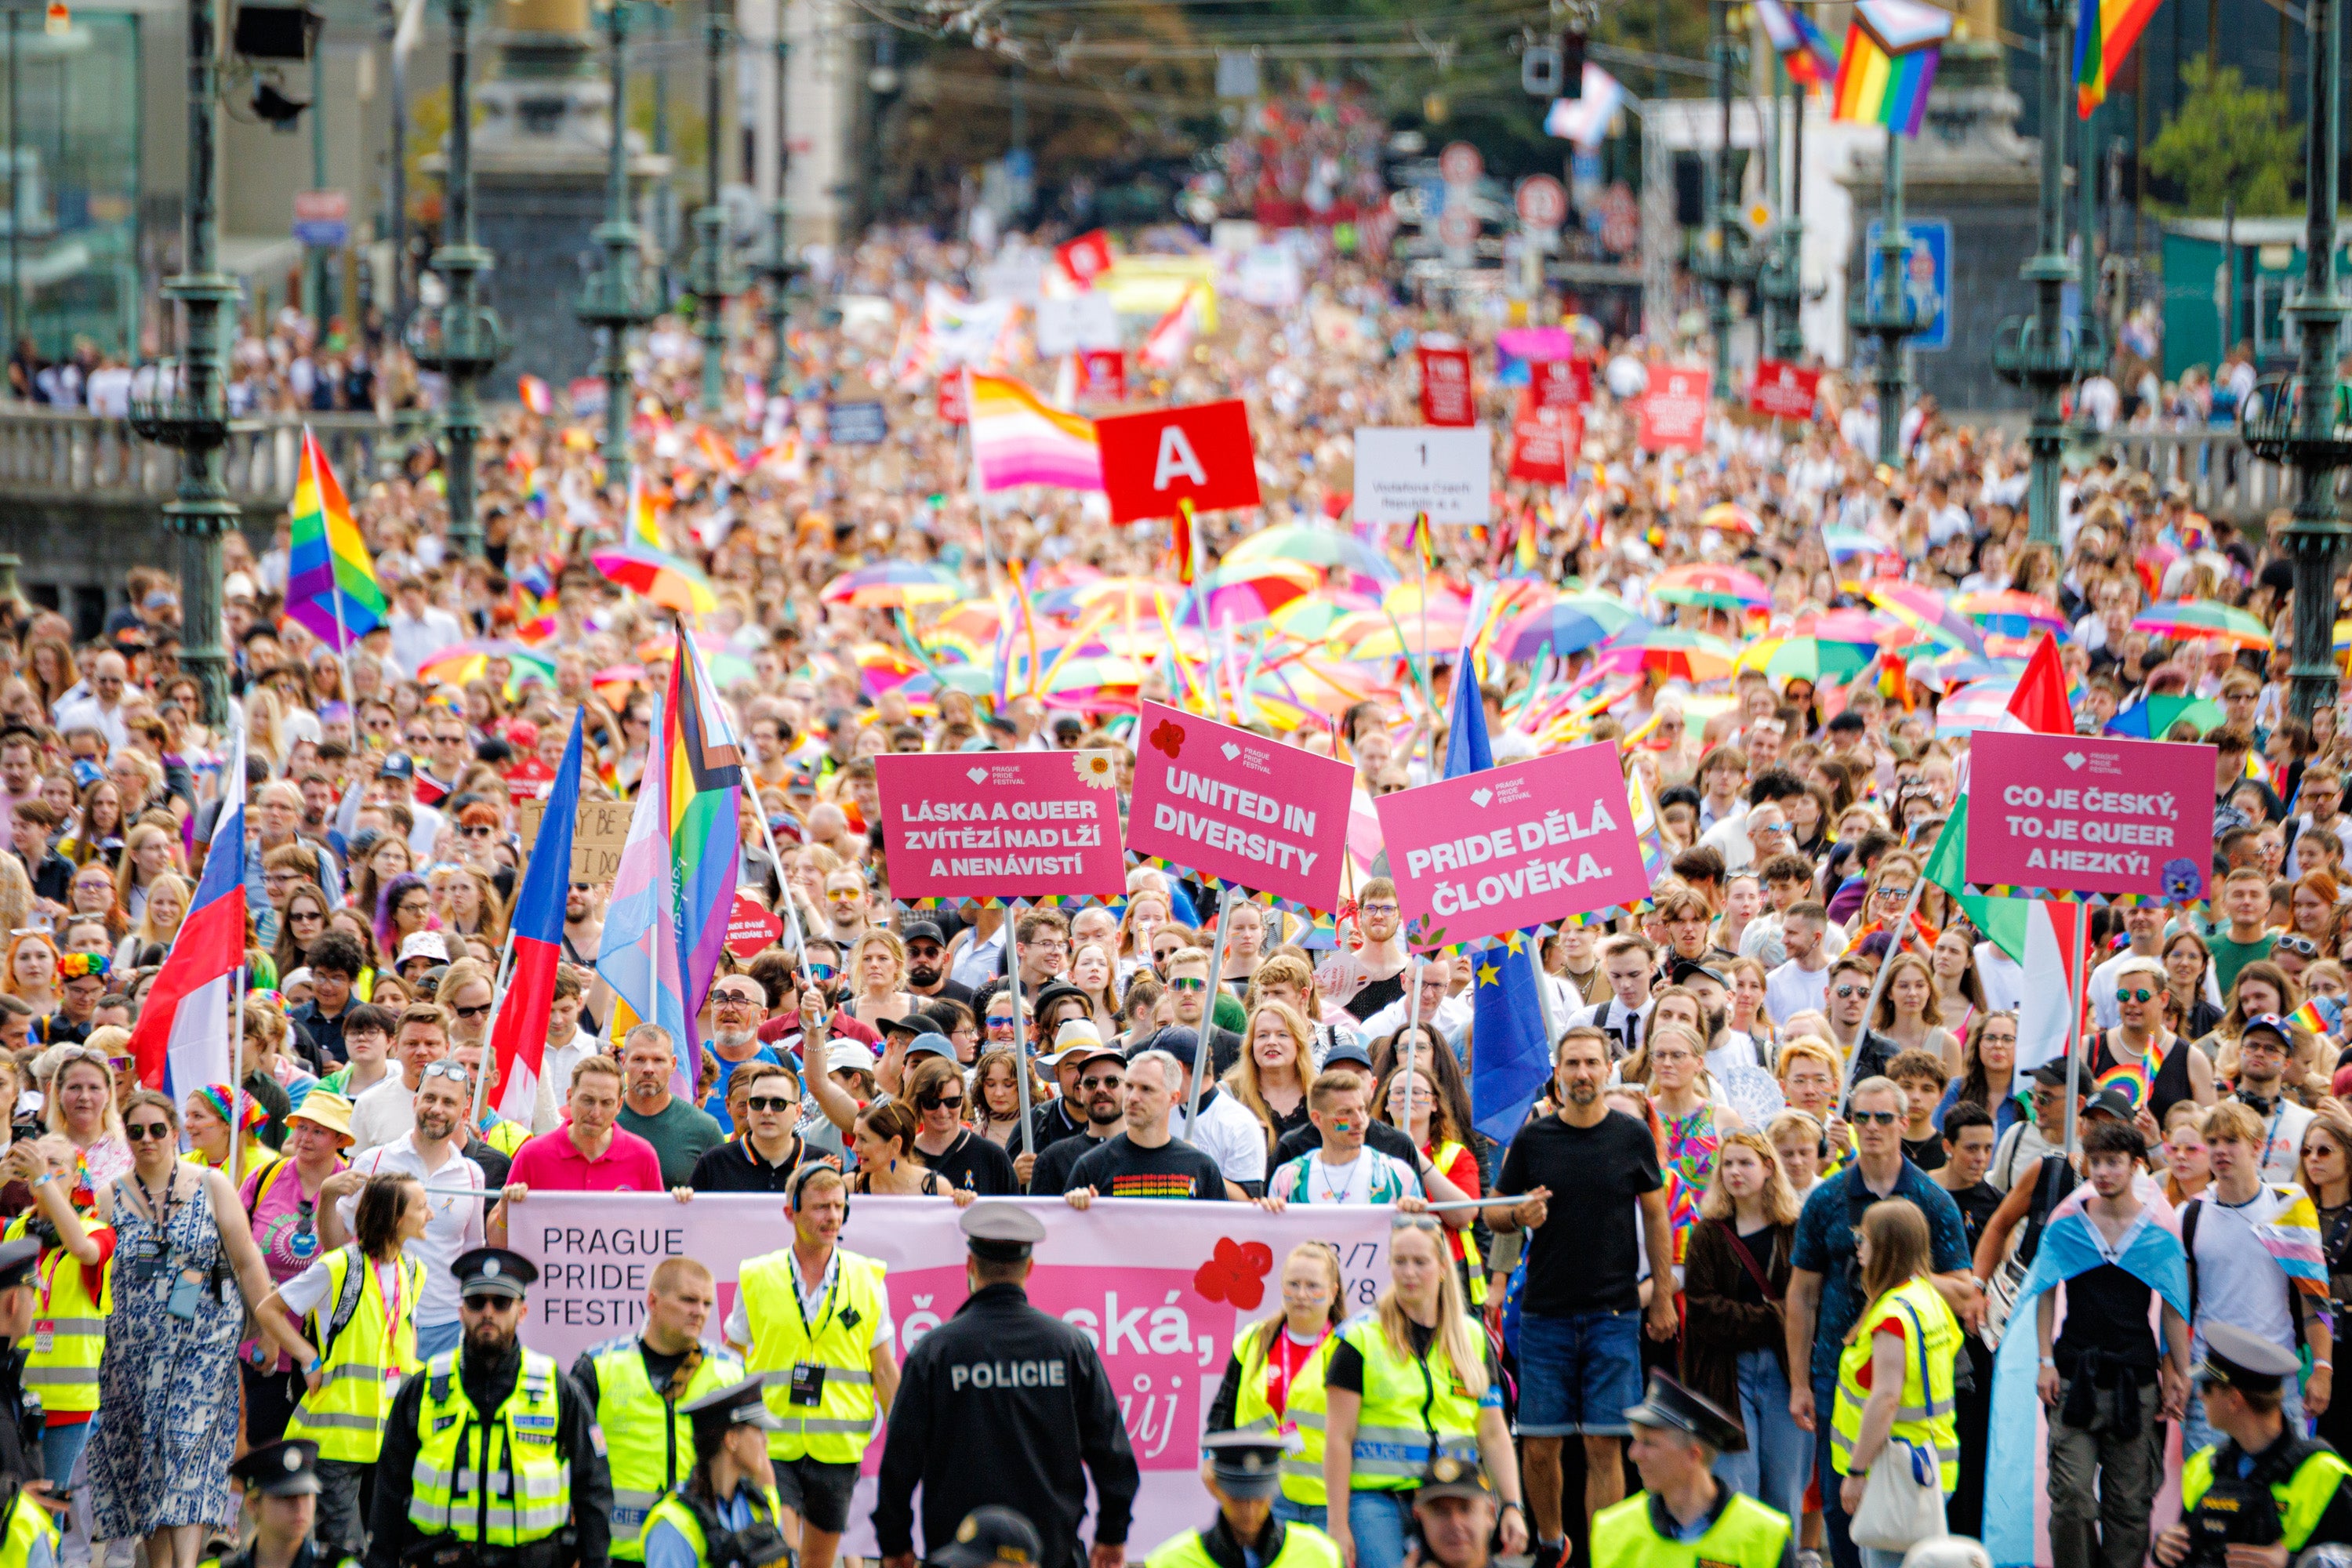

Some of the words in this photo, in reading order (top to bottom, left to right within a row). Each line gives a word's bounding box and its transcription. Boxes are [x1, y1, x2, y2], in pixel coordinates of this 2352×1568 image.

[1153, 425, 1207, 491] A
[1415, 443, 1427, 467] 1
[1243, 754, 1263, 764] PRIDE
[1244, 747, 1270, 760] PRAGUE
[1243, 760, 1271, 775] FESTIVAL
[1495, 777, 1524, 790] PRAGUE
[1497, 786, 1519, 797] PRIDE
[1166, 766, 1280, 824] UNITED
[1283, 804, 1316, 837] IN
[1498, 791, 1531, 804] FESTIVAL
[2004, 786, 2044, 807] CO
[2046, 788, 2080, 810] JE
[2082, 786, 2179, 821] ČESKÝ,
[597, 808, 617, 837] BE
[902, 800, 987, 822] LÁSKA
[990, 802, 1009, 821] A
[1011, 800, 1098, 821] QUEER
[905, 826, 1000, 849] ZVÍTĚZÍ
[1005, 829, 1058, 848] NAD
[1062, 825, 1101, 847] LŽÍ
[1154, 803, 1318, 877] DIVERSITY
[1406, 827, 1516, 879] PRIDE
[1518, 799, 1617, 853] DĚLÁ
[2005, 815, 2043, 837] TO
[2045, 819, 2079, 840] JE
[2082, 822, 2174, 848] QUEER
[598, 851, 621, 877] DO
[930, 858, 949, 877] A
[951, 852, 1082, 876] NENÁVISTÍ
[2026, 848, 2047, 869] A
[2049, 850, 2150, 877] HEZKÝ!
[1432, 852, 1613, 917] ČLOVĚKA.
[544, 1229, 683, 1254] PRAGUE
[544, 1265, 644, 1290] PRIDE
[544, 1299, 645, 1326] FESTI
[951, 1359, 1065, 1392] POLICIE
